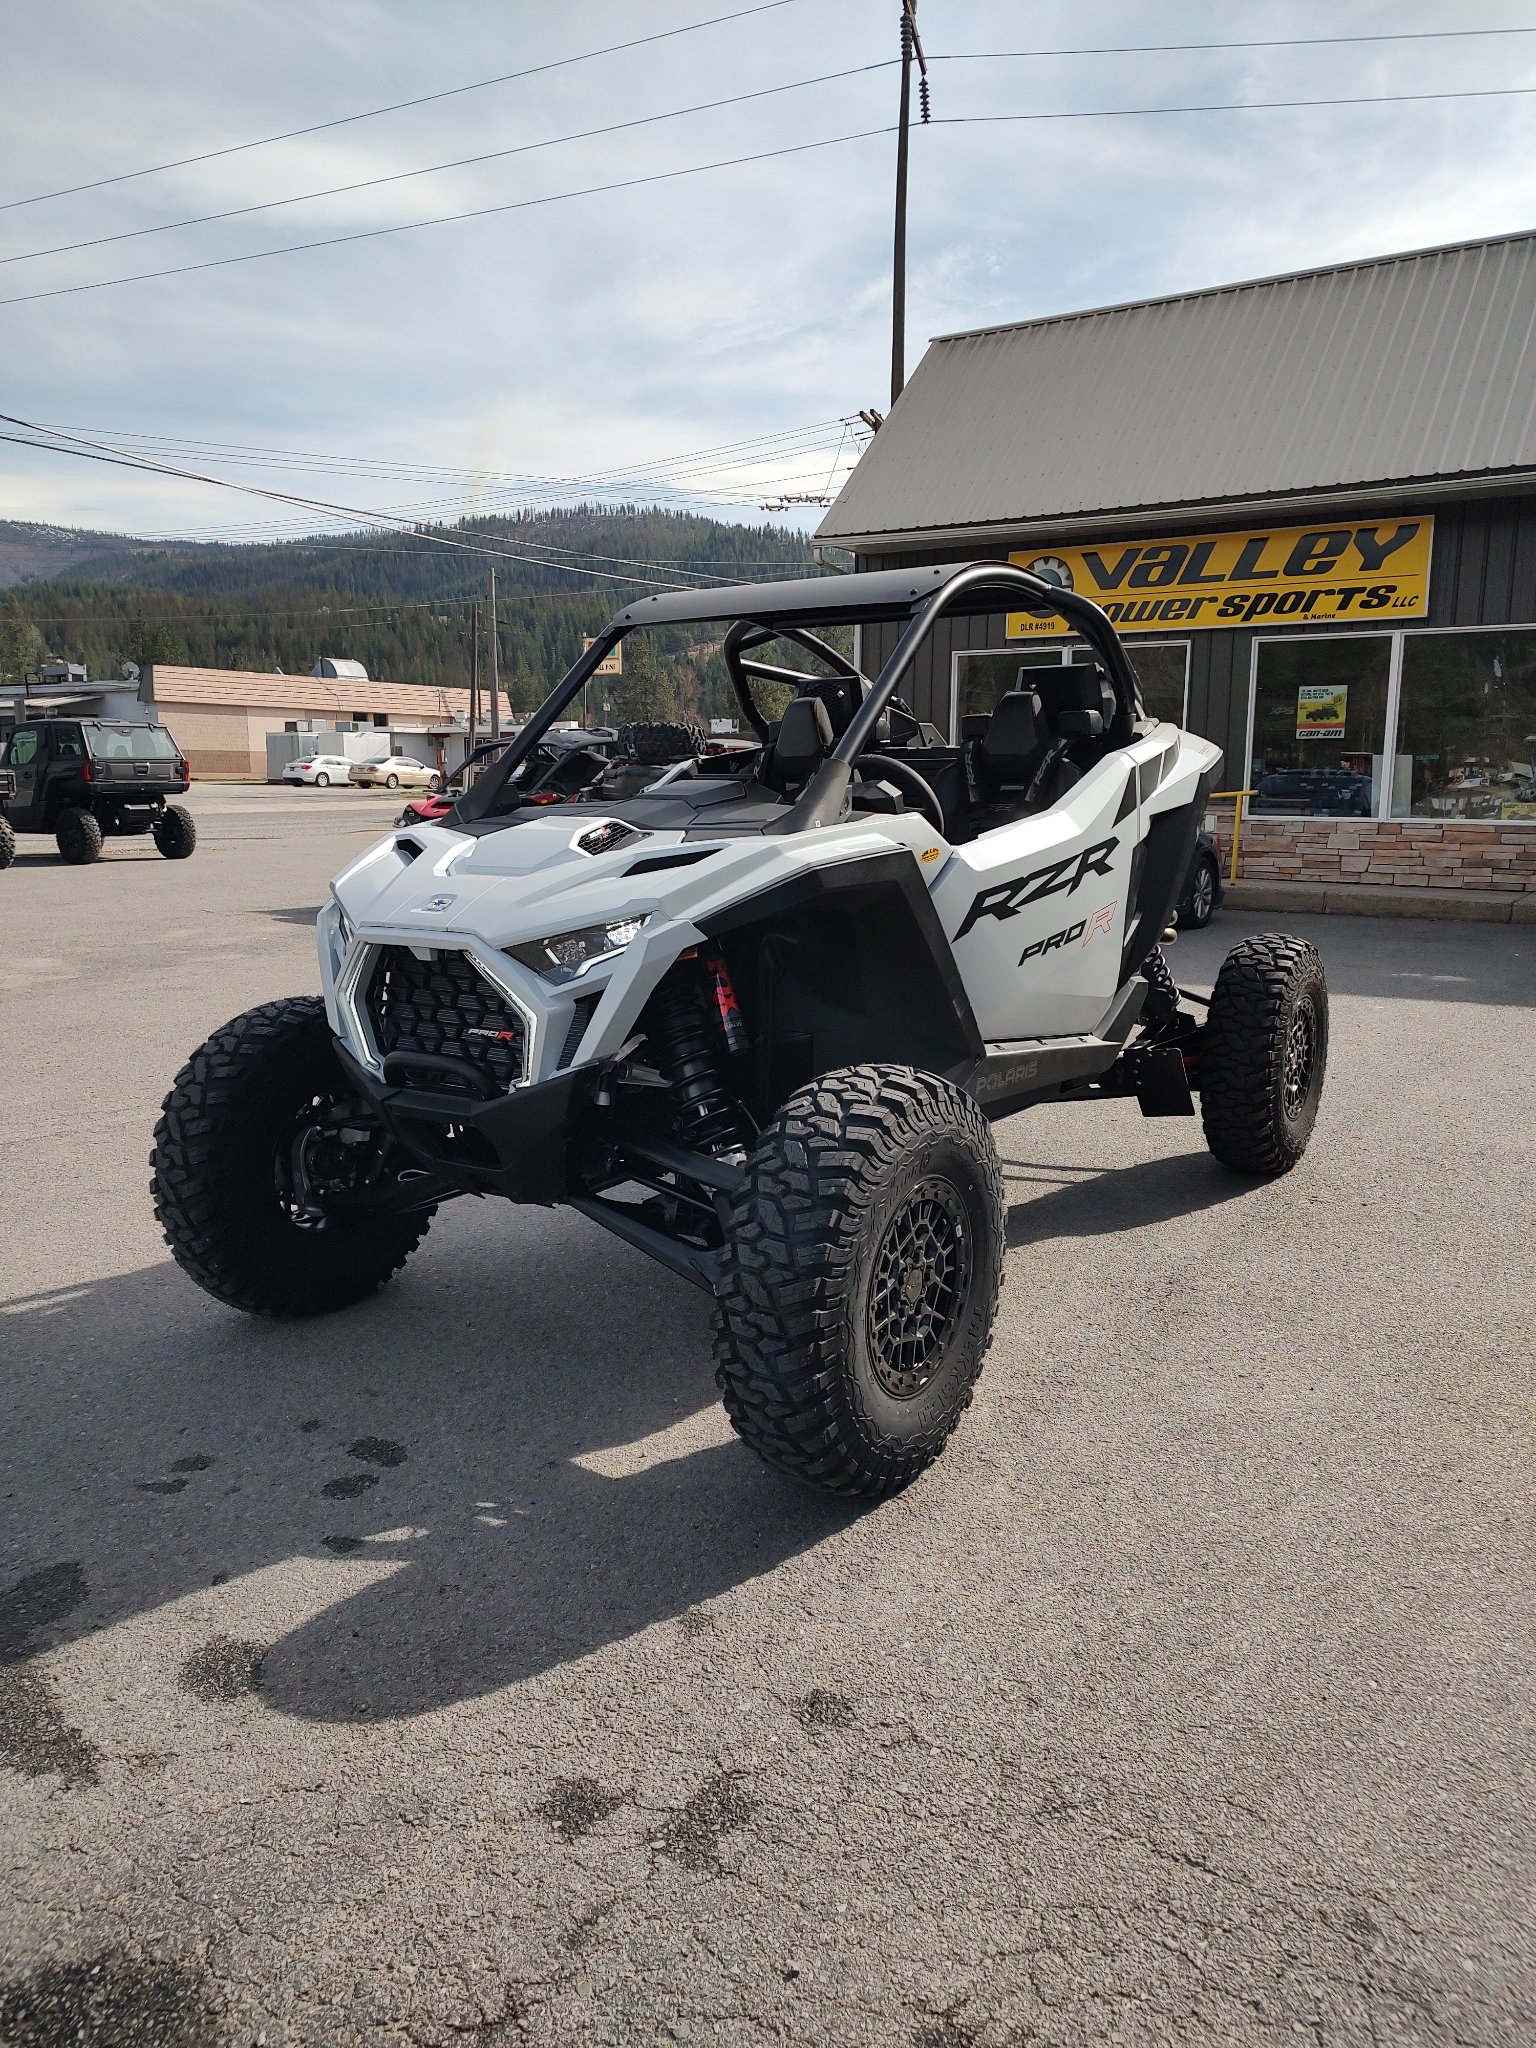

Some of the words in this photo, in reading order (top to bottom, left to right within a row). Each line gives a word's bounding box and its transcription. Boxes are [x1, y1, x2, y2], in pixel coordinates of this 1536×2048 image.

[1020, 622, 1033, 631] DLR
[1034, 621, 1055, 631] #4919
[1072, 596, 1218, 631] ower
[1391, 595, 1419, 608] LLC
[1310, 612, 1336, 620] Marine
[1298, 729, 1342, 737] can-am
[951, 836, 1121, 945] RZR
[1017, 918, 1088, 967] PRO
[1082, 900, 1119, 949] R
[975, 1060, 1039, 1095] POLARIS
